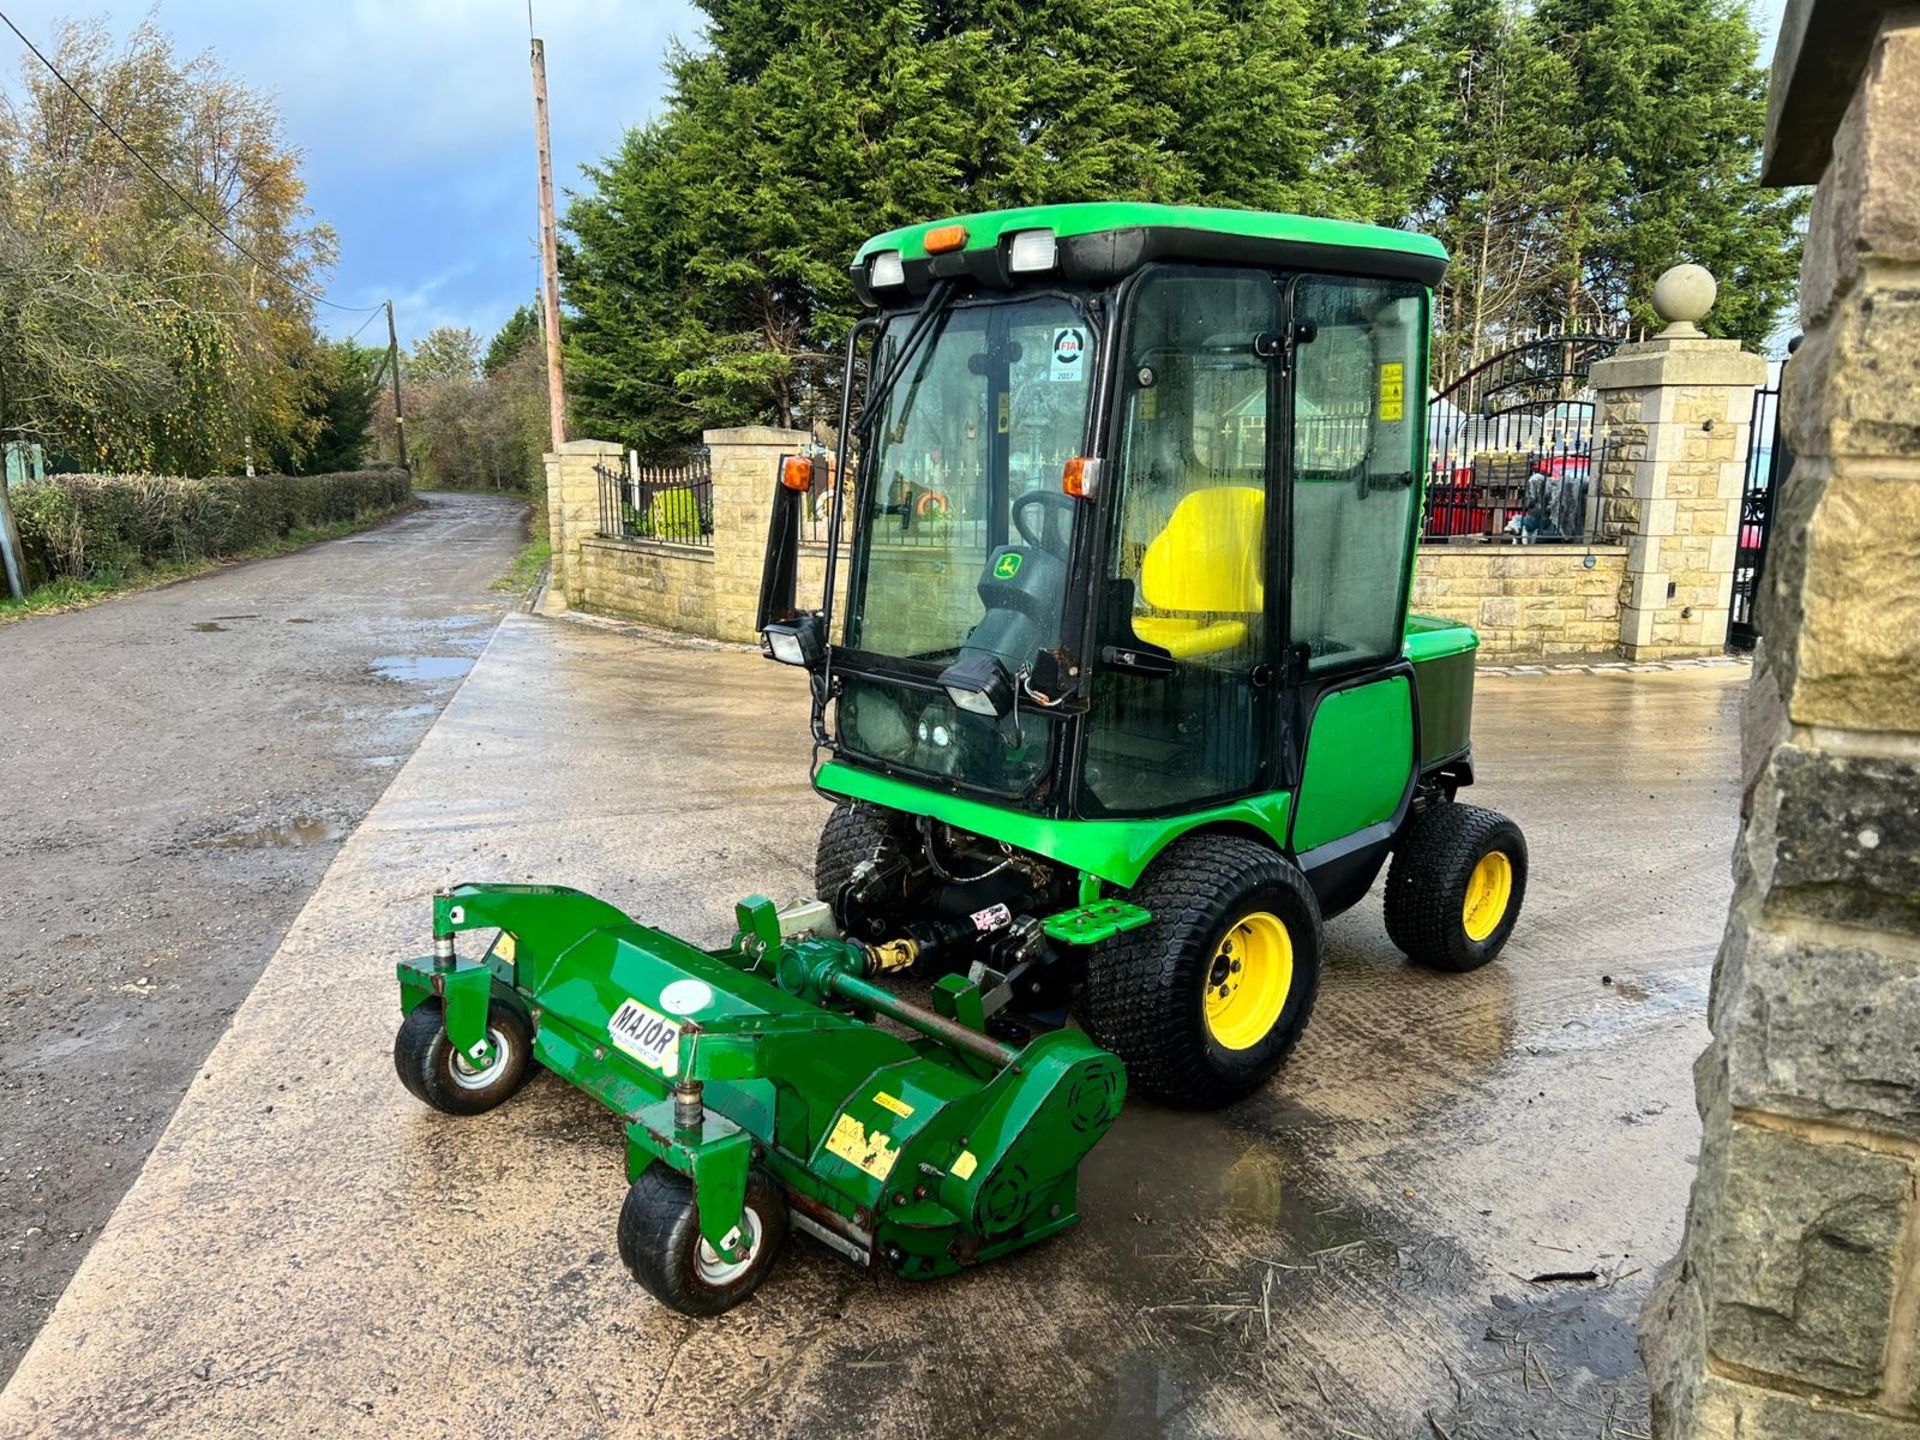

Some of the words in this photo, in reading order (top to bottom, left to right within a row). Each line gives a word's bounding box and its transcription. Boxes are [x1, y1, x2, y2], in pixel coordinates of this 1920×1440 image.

[1061, 342, 1076, 350] FTA
[1057, 372, 1074, 380] 2017
[612, 1005, 676, 1054] MAJOR
